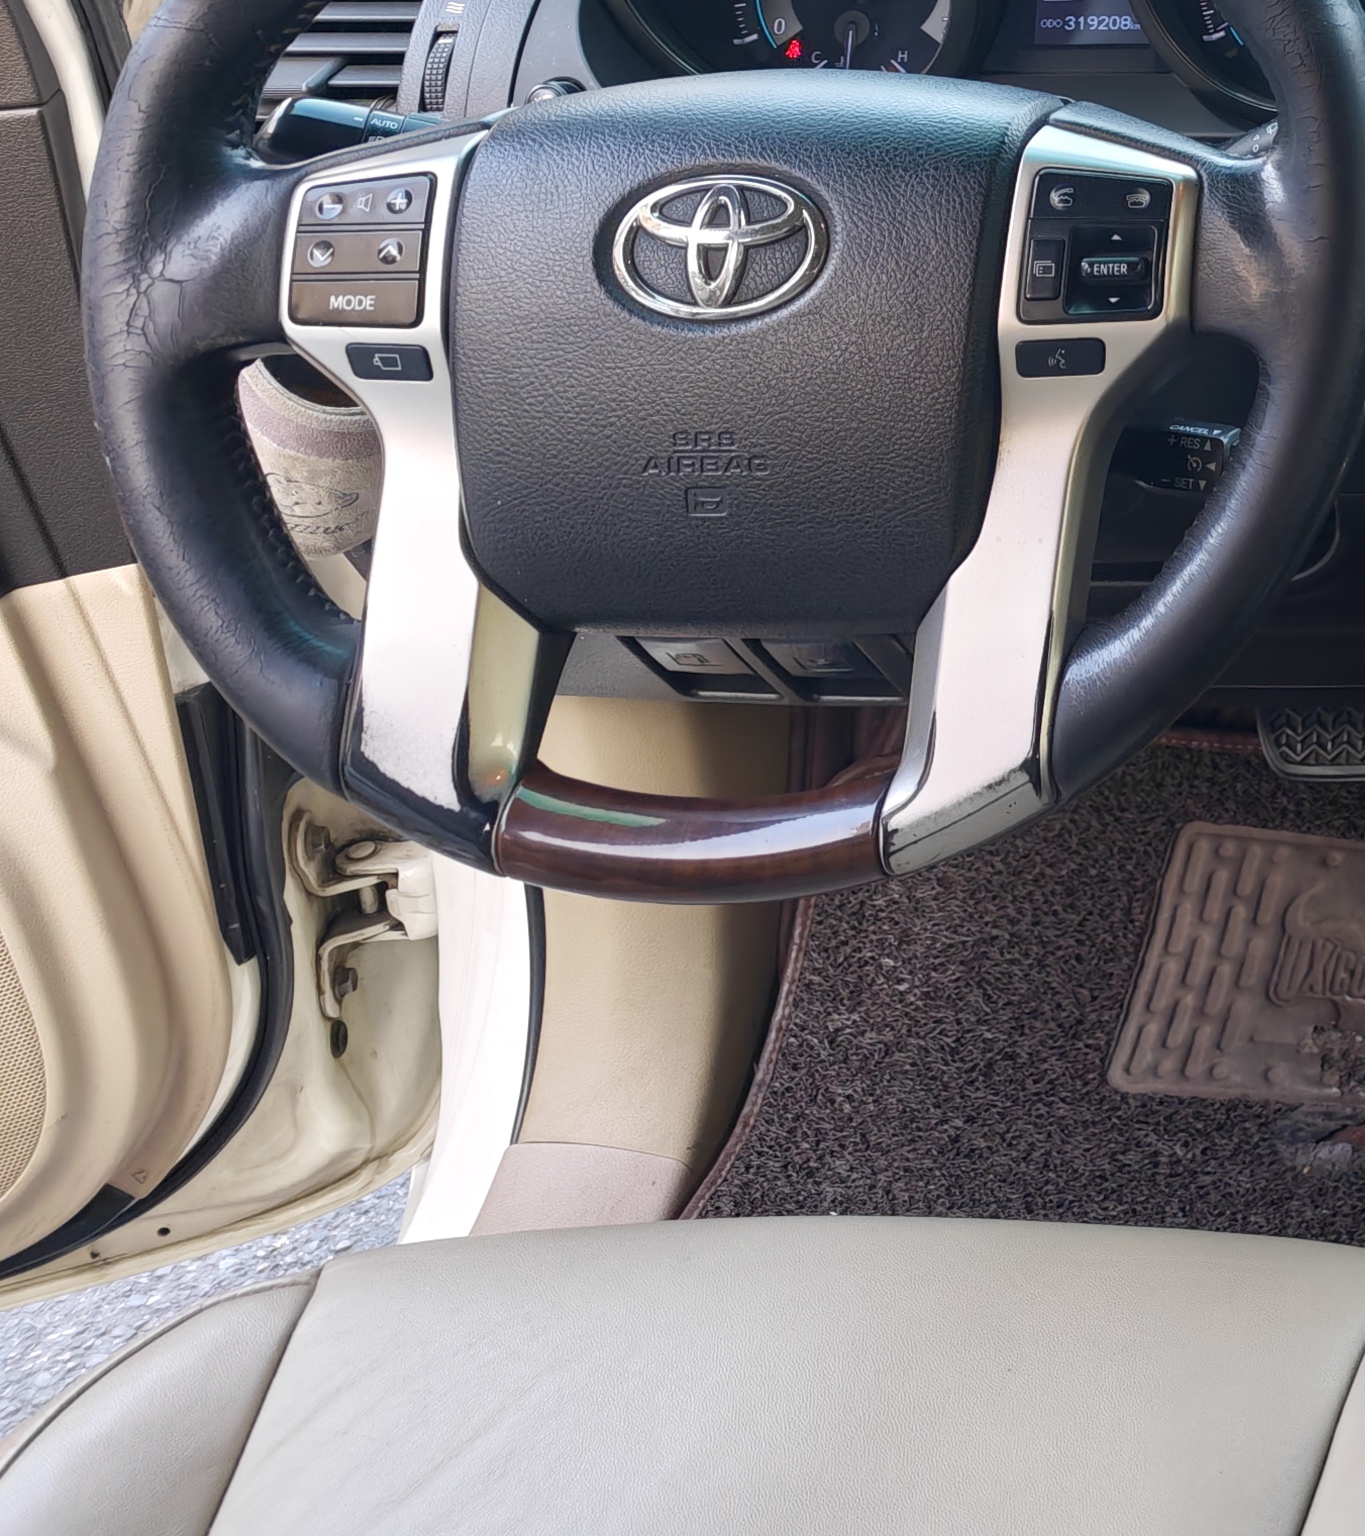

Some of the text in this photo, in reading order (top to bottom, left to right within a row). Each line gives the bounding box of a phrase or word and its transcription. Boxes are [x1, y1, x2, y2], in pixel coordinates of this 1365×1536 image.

[773, 18, 786, 35] 0
[1040, 19, 1062, 28] ODO
[1064, 16, 1131, 31] 319208
[811, 51, 821, 64] C
[897, 50, 908, 64] H
[370, 117, 398, 130] AUTO
[1093, 264, 1128, 275] ENTER
[328, 295, 376, 311] MODE
[1169, 424, 1209, 435] CANCEL
[1180, 437, 1201, 449] RES
[641, 455, 770, 476] AIRBAG
[1174, 477, 1195, 490] SET
